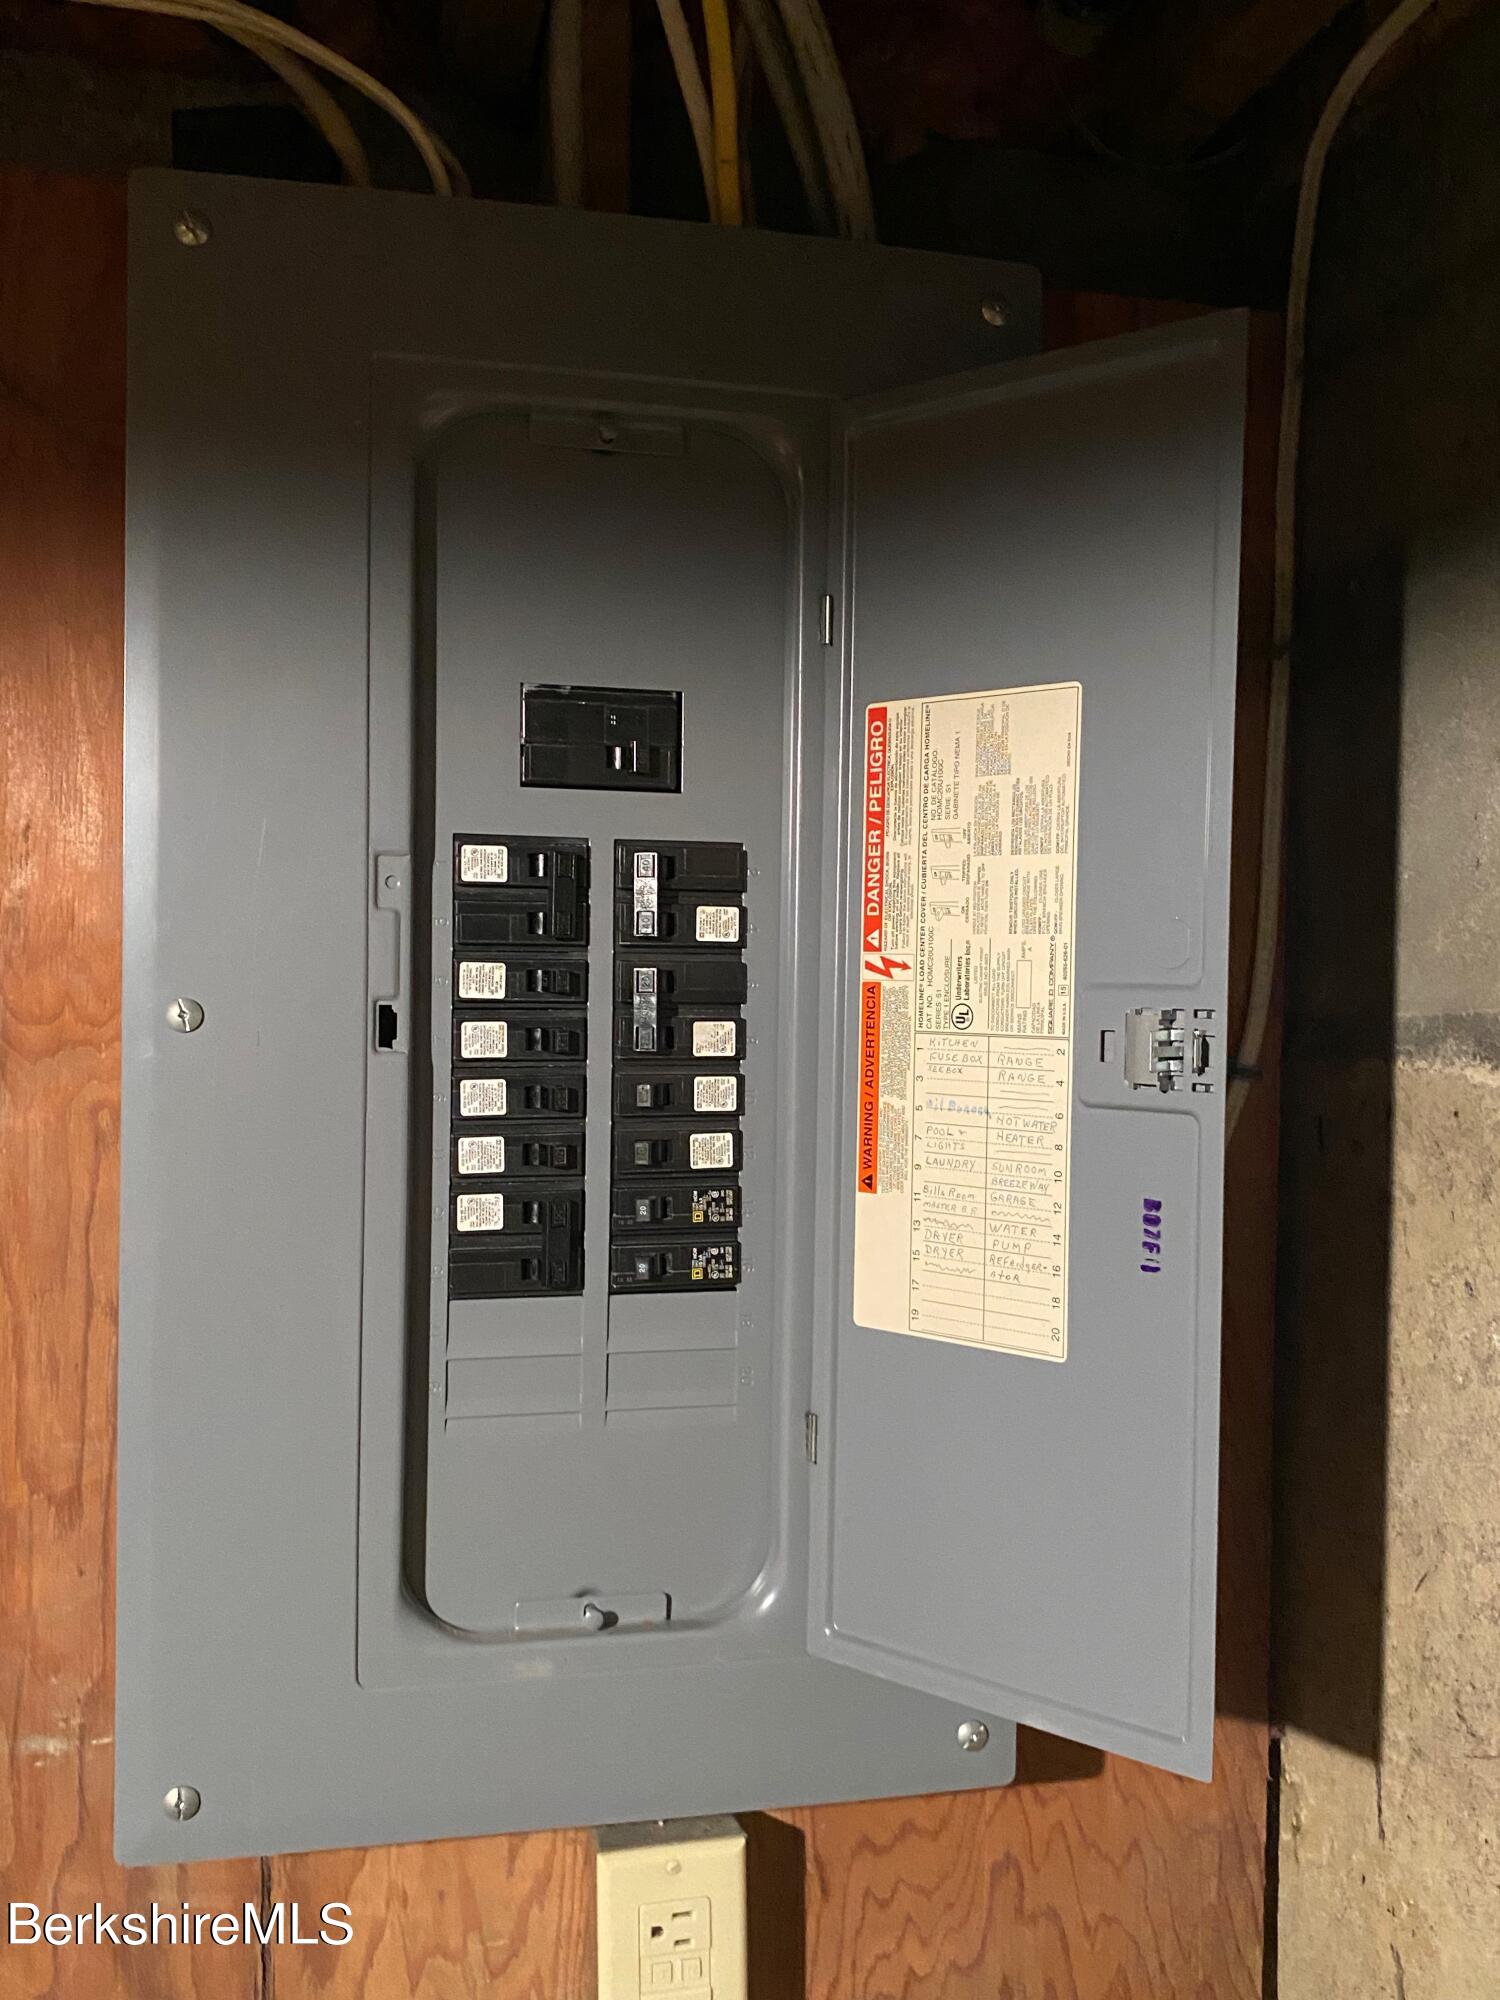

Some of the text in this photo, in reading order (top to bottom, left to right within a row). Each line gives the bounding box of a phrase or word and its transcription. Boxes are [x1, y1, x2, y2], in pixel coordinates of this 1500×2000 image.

[869, 721, 884, 812] PELIGRO
[924, 784, 929, 794] DE
[867, 830, 880, 916] DANGER
[1060, 986, 1066, 994] 15
[955, 1009, 969, 1024] UL
[864, 986, 876, 1088] ADVERTENCIA
[998, 1054, 1044, 1067] RANGE
[998, 1070, 1046, 1084] RANGE
[863, 1102, 873, 1170] WARNING
[997, 1130, 1044, 1147] HEATER
[926, 1156, 976, 1172] LAUNDRY
[1054, 1171, 1063, 1183] 10
[914, 1191, 921, 1201] 11
[639, 1205, 647, 1215] 20
[1053, 1203, 1062, 1214] 12
[914, 1220, 921, 1231] 13
[990, 1223, 1037, 1238] WATER
[924, 1229, 964, 1243] DRYER
[1053, 1234, 1061, 1246] 14
[925, 1245, 964, 1261] DRYER
[993, 1240, 1031, 1255] PUMP
[913, 1250, 920, 1260] 15
[638, 1263, 646, 1273] 20
[1053, 1266, 1061, 1277] 16
[912, 1279, 920, 1290] 17
[1052, 1297, 1061, 1309] 18
[912, 1309, 919, 1320] 19
[1051, 1327, 1060, 1342] 20
